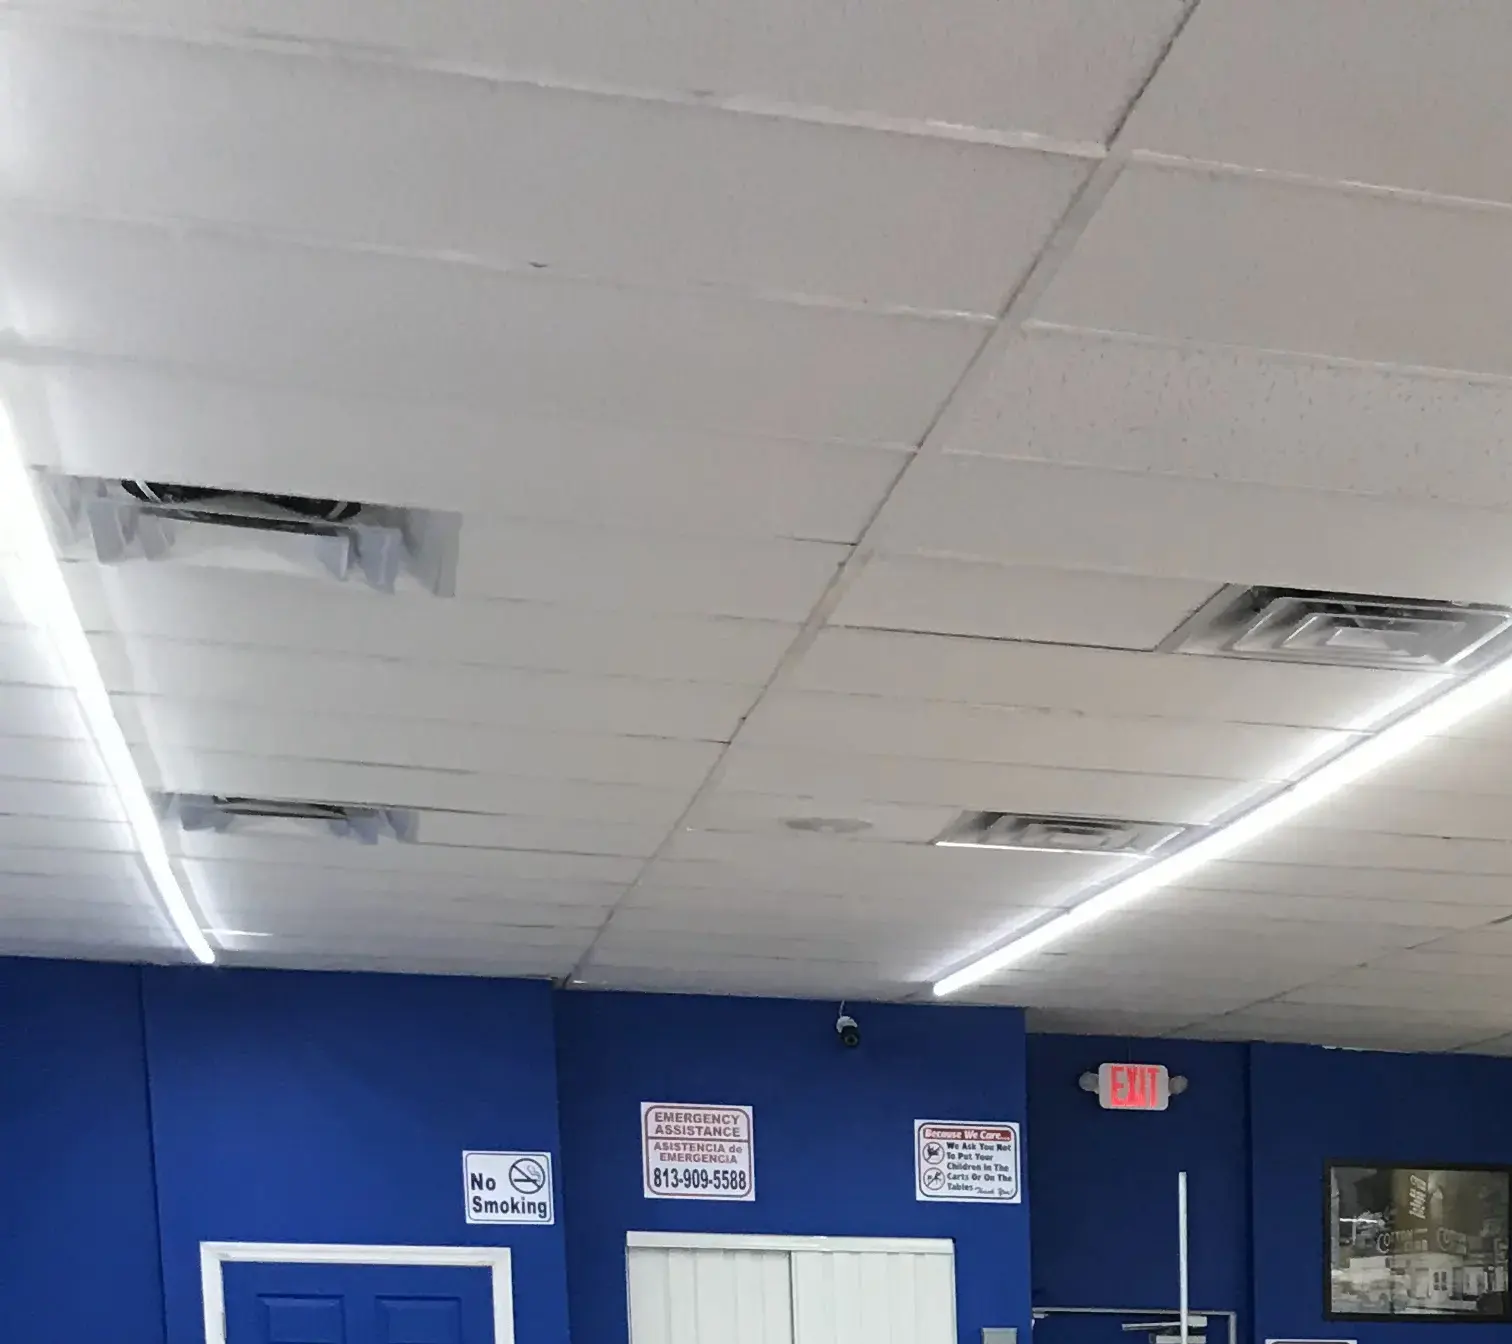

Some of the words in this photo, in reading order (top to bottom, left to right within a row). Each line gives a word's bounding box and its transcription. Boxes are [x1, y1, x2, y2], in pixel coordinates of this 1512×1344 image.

[1111, 1065, 1159, 1107] EXIT
[655, 1111, 740, 1125] EMERGENCY
[655, 1124, 741, 1137] ASSISTANCE
[924, 1129, 962, 1139] Because
[964, 1130, 978, 1139] We
[653, 1141, 726, 1153] ASISTENCIA
[728, 1144, 743, 1153] de
[946, 1142, 959, 1150] We
[962, 1142, 976, 1150] Ask
[980, 1143, 994, 1151] You
[996, 1144, 1012, 1152] Not
[659, 1152, 738, 1164] EMERGENCIA
[946, 1152, 956, 1160] To
[958, 1152, 973, 1160] Put
[974, 1153, 993, 1161] Your
[946, 1162, 982, 1171] Children
[994, 1164, 1010, 1172] The
[470, 1173, 496, 1191] No
[653, 1167, 747, 1190] 813-909-5588
[946, 1172, 969, 1181] Carts
[971, 1173, 981, 1181] Or
[997, 1174, 1013, 1182] The
[947, 1182, 974, 1191] Tables
[472, 1195, 547, 1219] Smoking
